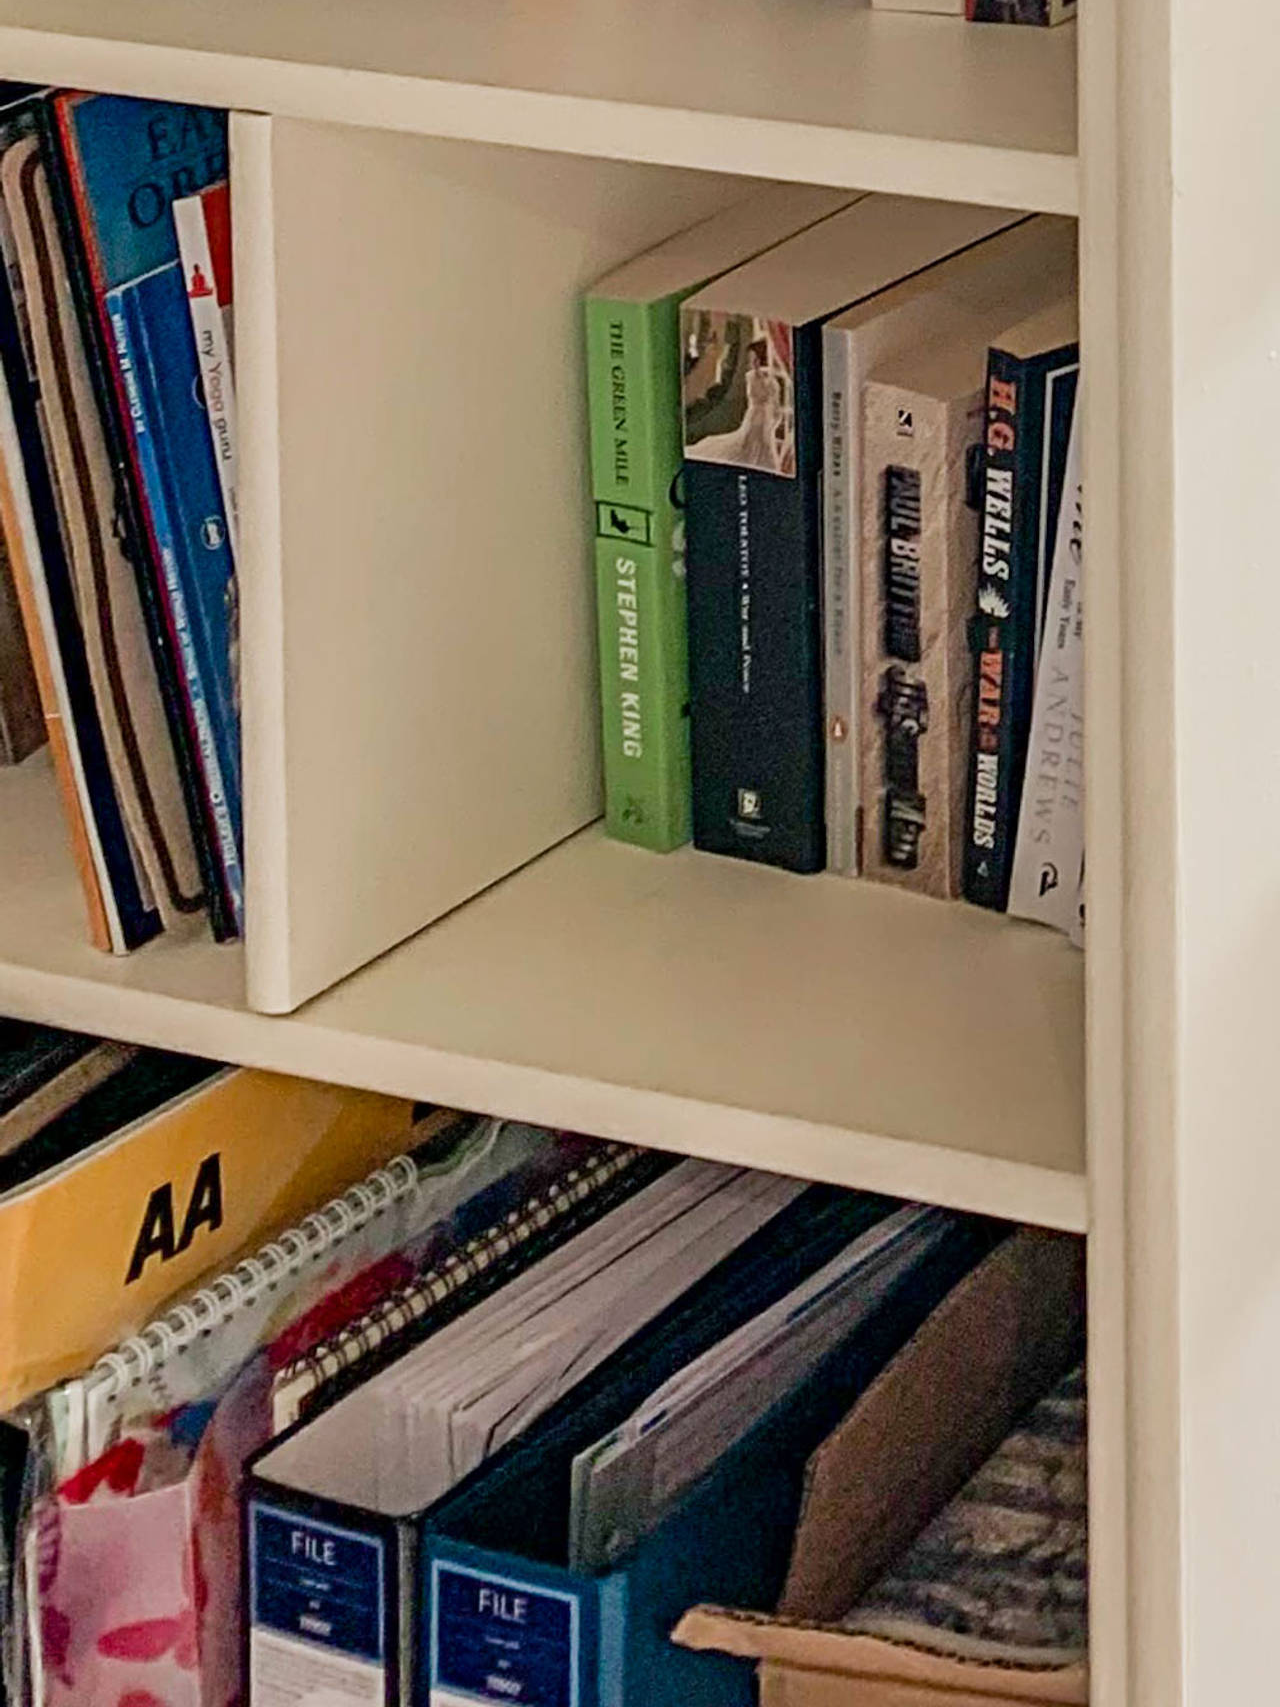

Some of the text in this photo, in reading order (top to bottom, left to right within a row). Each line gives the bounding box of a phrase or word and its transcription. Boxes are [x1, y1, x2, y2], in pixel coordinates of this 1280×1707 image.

[201, 331, 233, 462] my Yoga guru
[609, 320, 629, 487] THE GREEN MILE
[616, 559, 642, 758] STEPHEN KING
[974, 750, 1001, 850] WORLDS
[126, 1152, 224, 1286] AA
[291, 1530, 336, 1566] FILE
[478, 1588, 527, 1622] FILE
